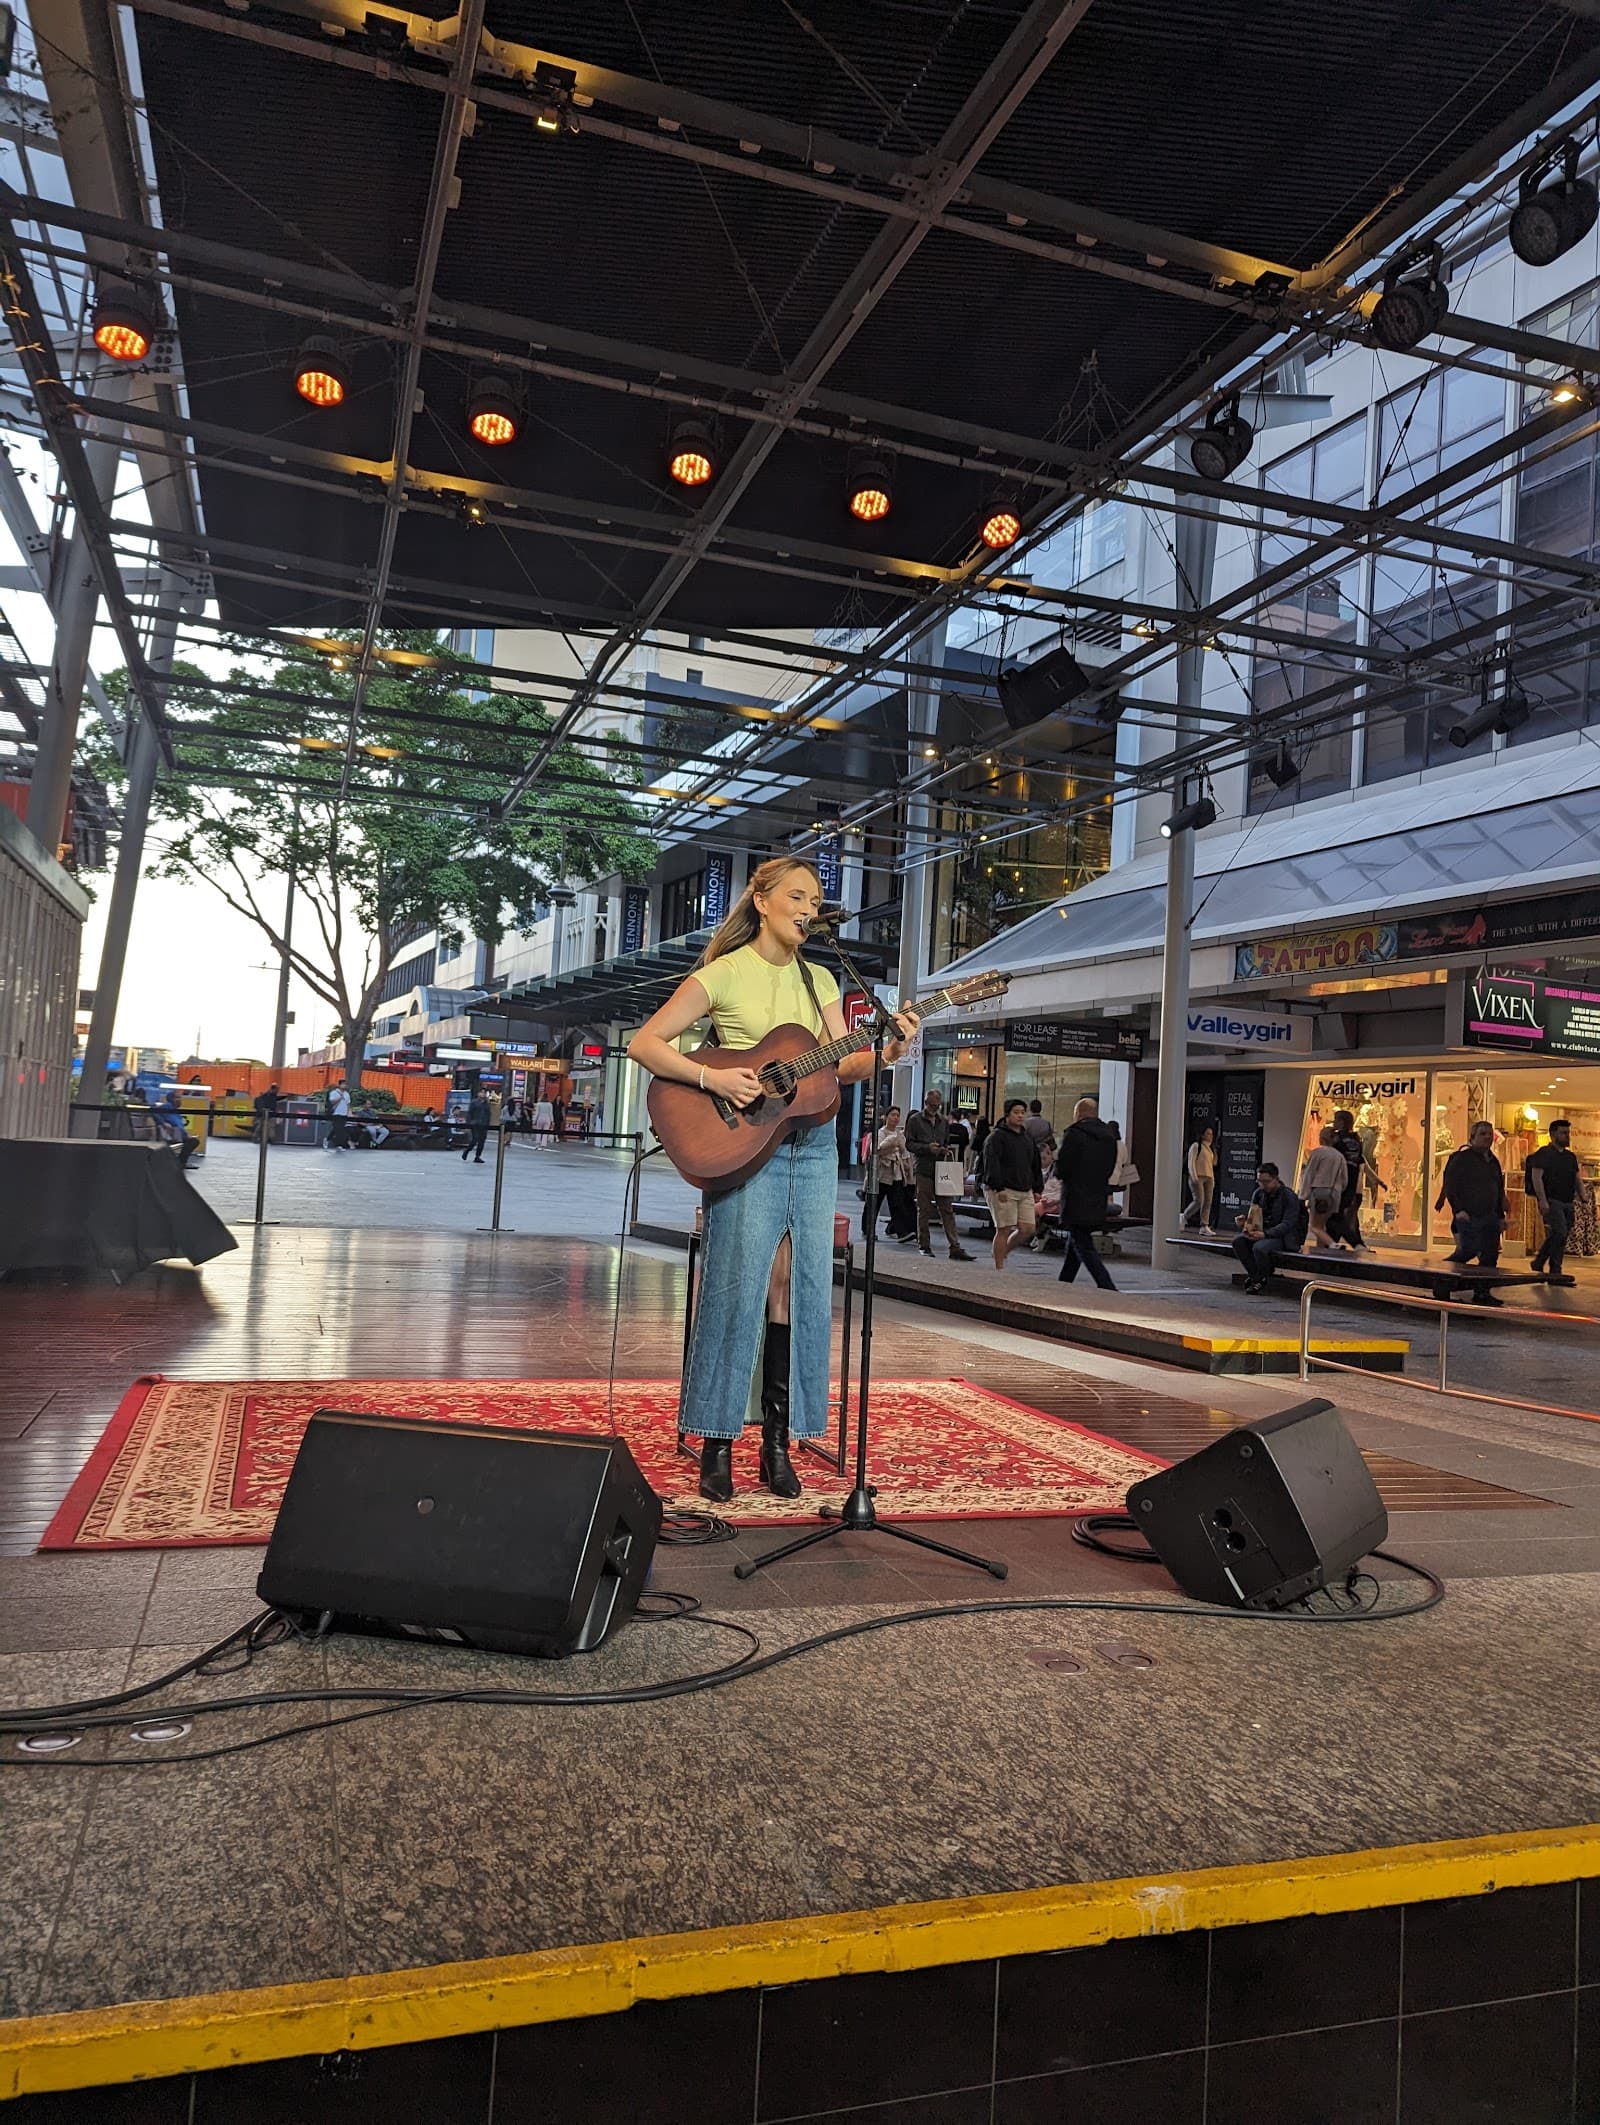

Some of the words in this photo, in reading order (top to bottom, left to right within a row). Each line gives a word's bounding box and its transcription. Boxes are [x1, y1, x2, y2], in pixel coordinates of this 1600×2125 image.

[706, 858, 721, 926] LENNONS
[625, 893, 638, 951] LENNONS
[1492, 928, 1507, 938] THE
[1509, 924, 1535, 935] VENUE
[1537, 921, 1558, 932] WITH
[1561, 920, 1567, 929] A
[1471, 986, 1545, 1029] VIXEN
[1013, 1023, 1032, 1033] FOR
[1033, 1024, 1058, 1036] LEASE
[1187, 1014, 1291, 1041] Valleygirl
[1118, 1032, 1141, 1045] belle
[1319, 1078, 1415, 1098] Valleygirl
[1189, 1092, 1212, 1103] PRIME
[1227, 1092, 1254, 1103] RETAIL
[1192, 1107, 1209, 1117] FOR
[1228, 1105, 1253, 1116] LEASE
[1220, 1192, 1240, 1205] belle
